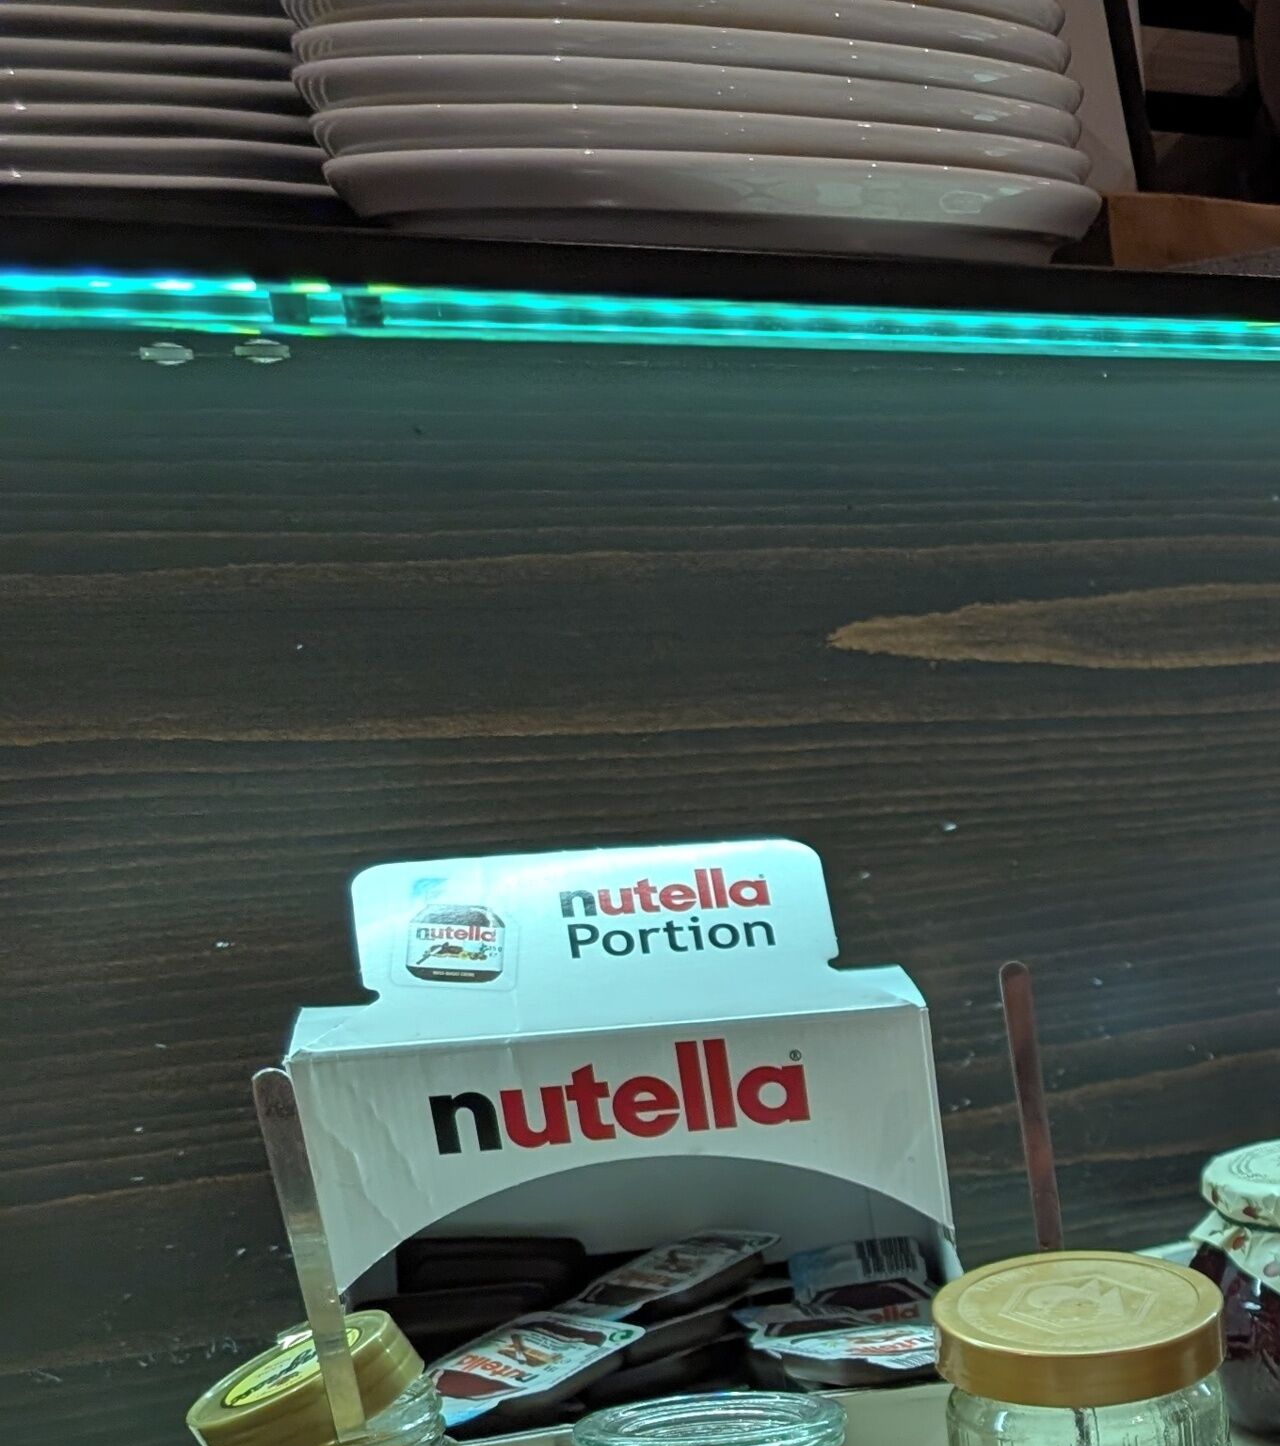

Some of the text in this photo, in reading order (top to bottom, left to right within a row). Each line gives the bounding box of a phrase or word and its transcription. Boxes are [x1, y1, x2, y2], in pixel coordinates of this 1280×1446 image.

[558, 867, 771, 918] nutella
[416, 925, 496, 942] nutella
[566, 914, 776, 959] Portion
[429, 1037, 812, 1156] nutella
